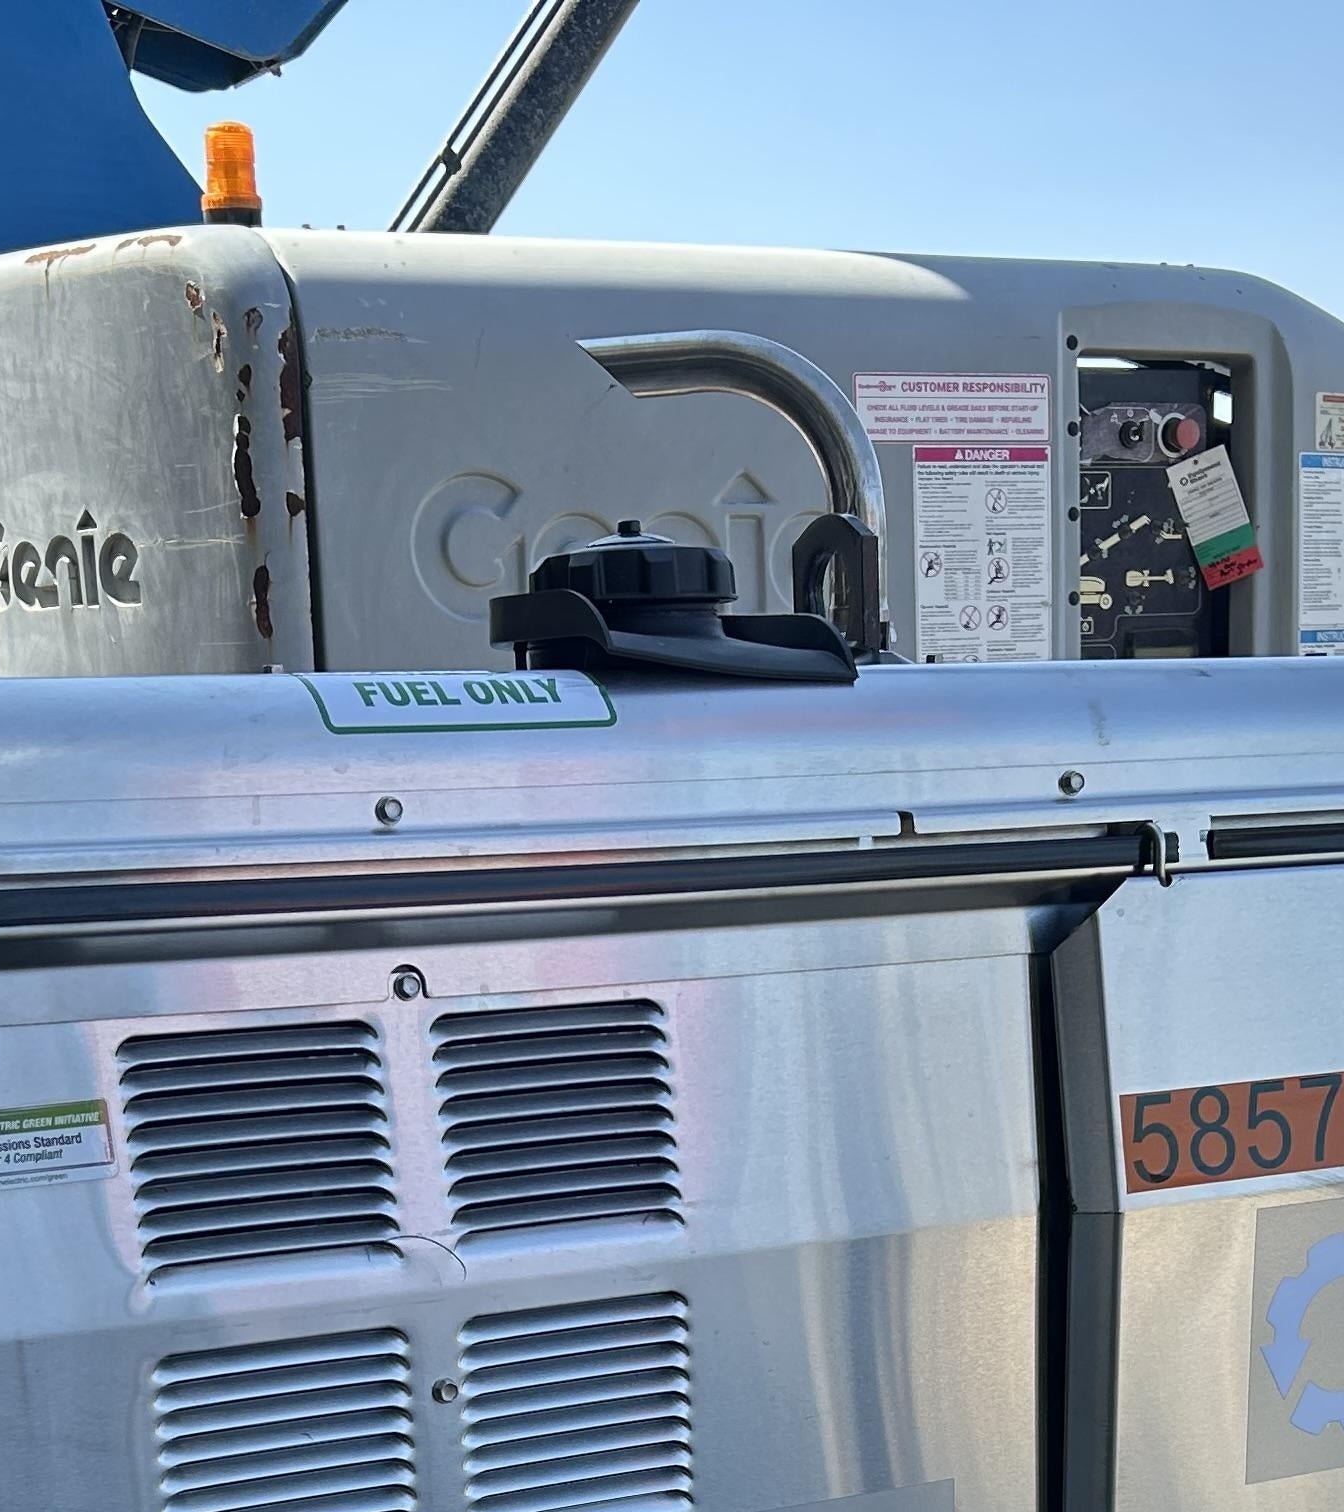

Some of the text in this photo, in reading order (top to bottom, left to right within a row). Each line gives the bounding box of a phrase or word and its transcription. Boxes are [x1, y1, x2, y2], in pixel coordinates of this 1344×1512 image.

[901, 381, 960, 393] CUSTOMER
[962, 382, 1046, 394] RESPONSIBILITY
[965, 450, 1010, 461] DANGER
[352, 677, 563, 708] FUEL ONLY
[22, 1116, 53, 1130] GREEN
[55, 1111, 100, 1127] INITIATIVE
[33, 1132, 83, 1149] Standard
[4, 1154, 12, 1165] 4
[13, 1149, 64, 1165] Compliant
